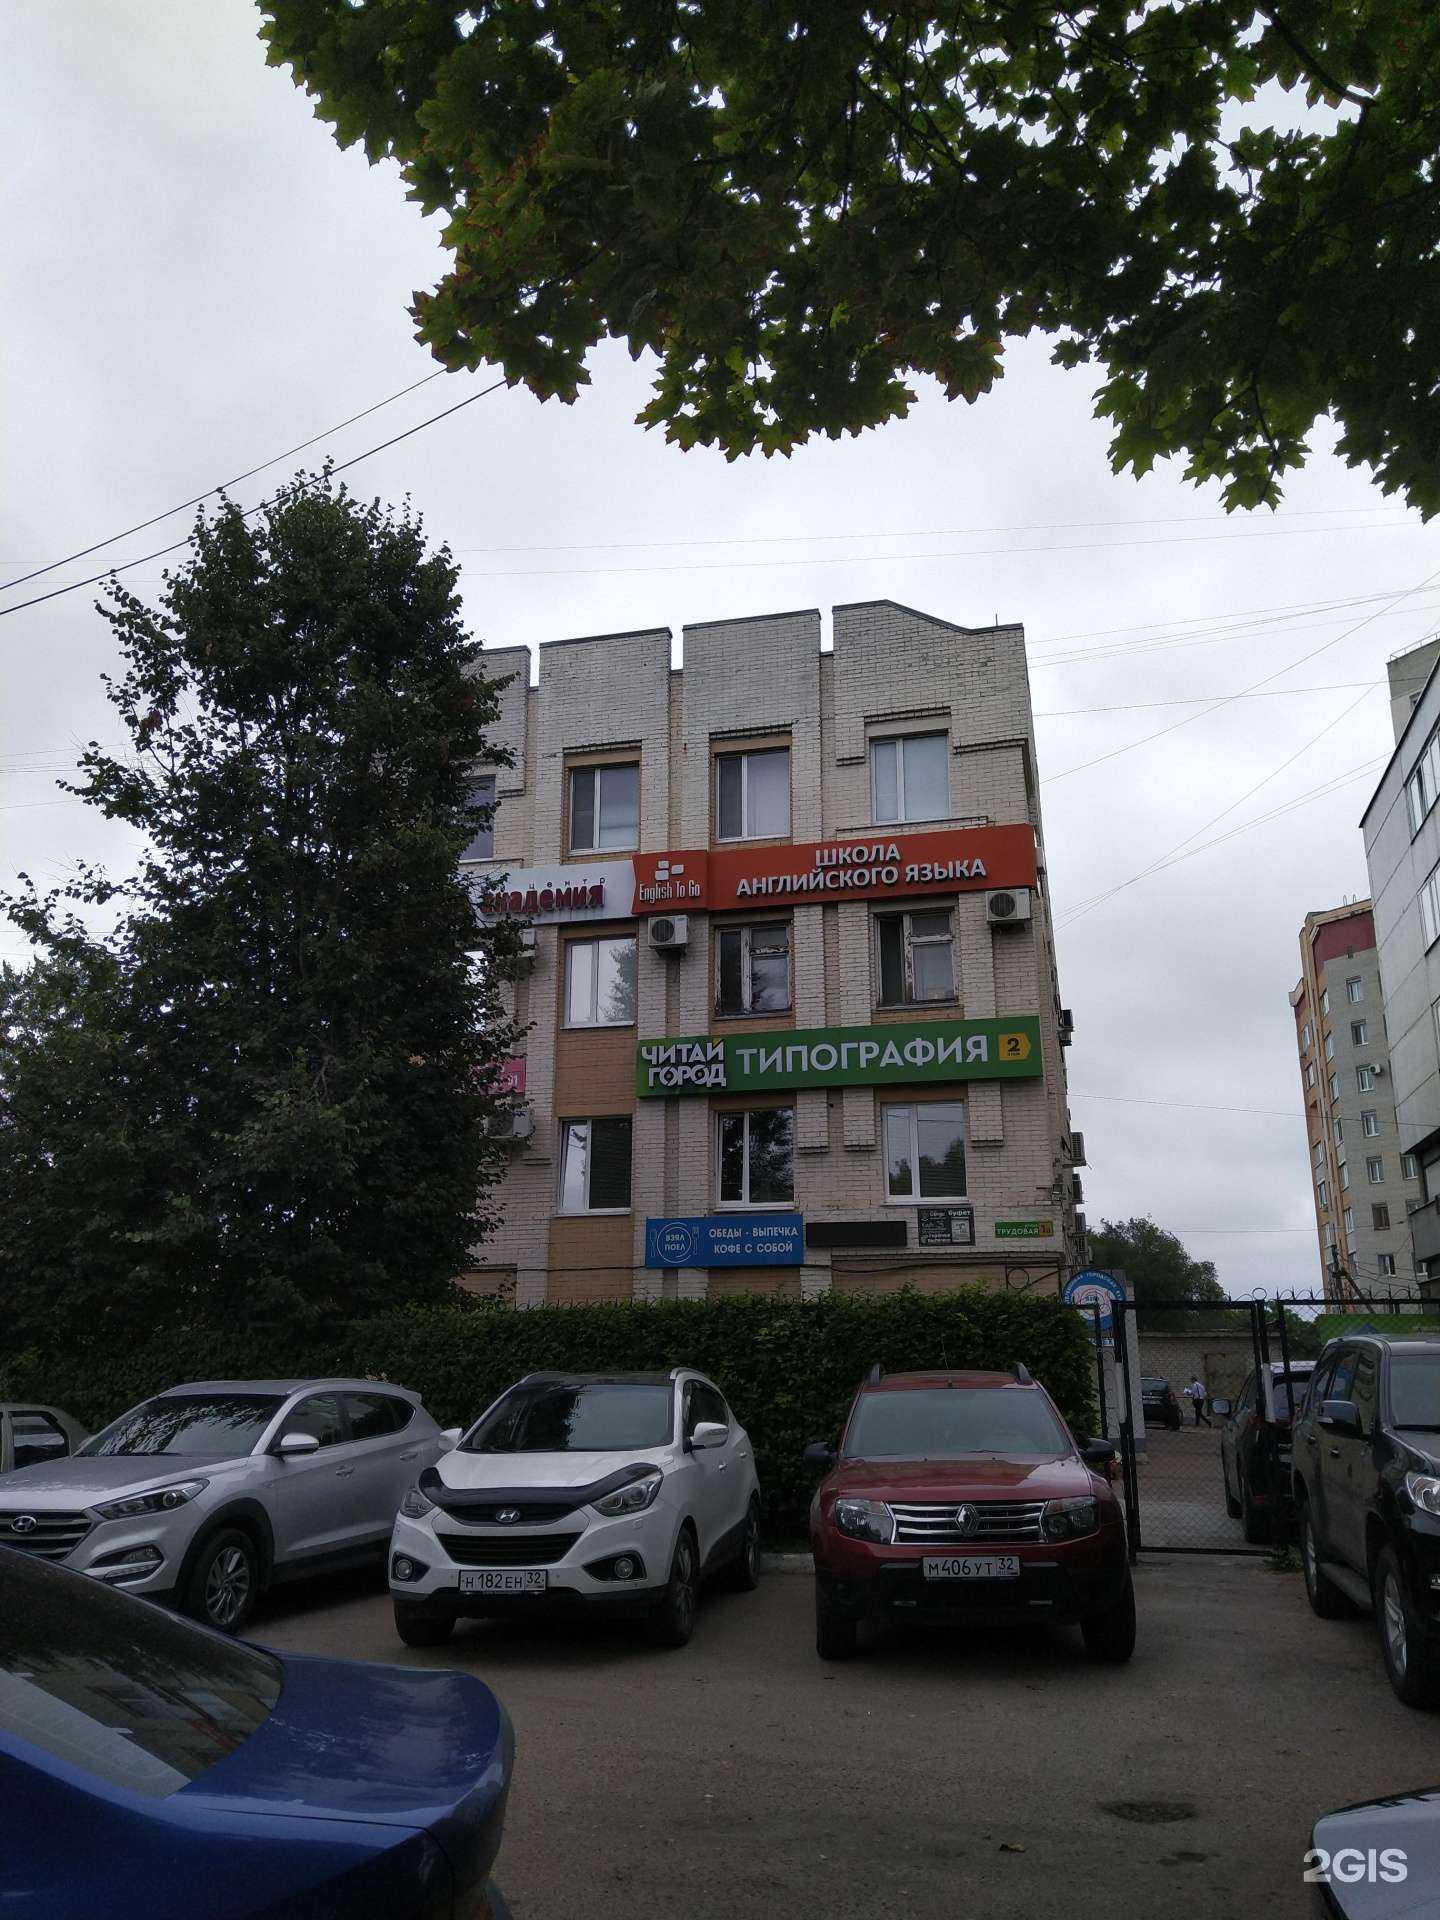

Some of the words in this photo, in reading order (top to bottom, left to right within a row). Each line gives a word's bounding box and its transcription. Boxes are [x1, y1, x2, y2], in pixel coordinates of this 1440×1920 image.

[815, 843, 901, 867] ШКОЛА
[736, 866, 899, 896] АНГЛИЙСКОГО
[905, 858, 987, 883] ЯЗЫКА
[639, 881, 673, 904] English
[675, 881, 686, 898] To
[688, 880, 701, 897] Go
[1008, 1038, 1021, 1052] 2
[641, 1039, 725, 1065] ЧИТАЙ
[736, 1034, 989, 1075] ТИПОГРАФИЯ
[648, 1063, 727, 1088] ГОРОД
[665, 1234, 685, 1242] ВЗЯЛ
[709, 1228, 742, 1239] ОБЕДЫ
[752, 1226, 799, 1238] ВЫПЕЧКА
[997, 1227, 1039, 1236] ТРУДОВАЯ
[664, 1243, 686, 1251] ПОЕЛ
[714, 1243, 741, 1254] КОФЕ
[745, 1244, 753, 1253] С
[757, 1241, 793, 1253] СОБОЙ
[998, 1557, 1014, 1570] 32
[526, 1572, 541, 1584] 32
